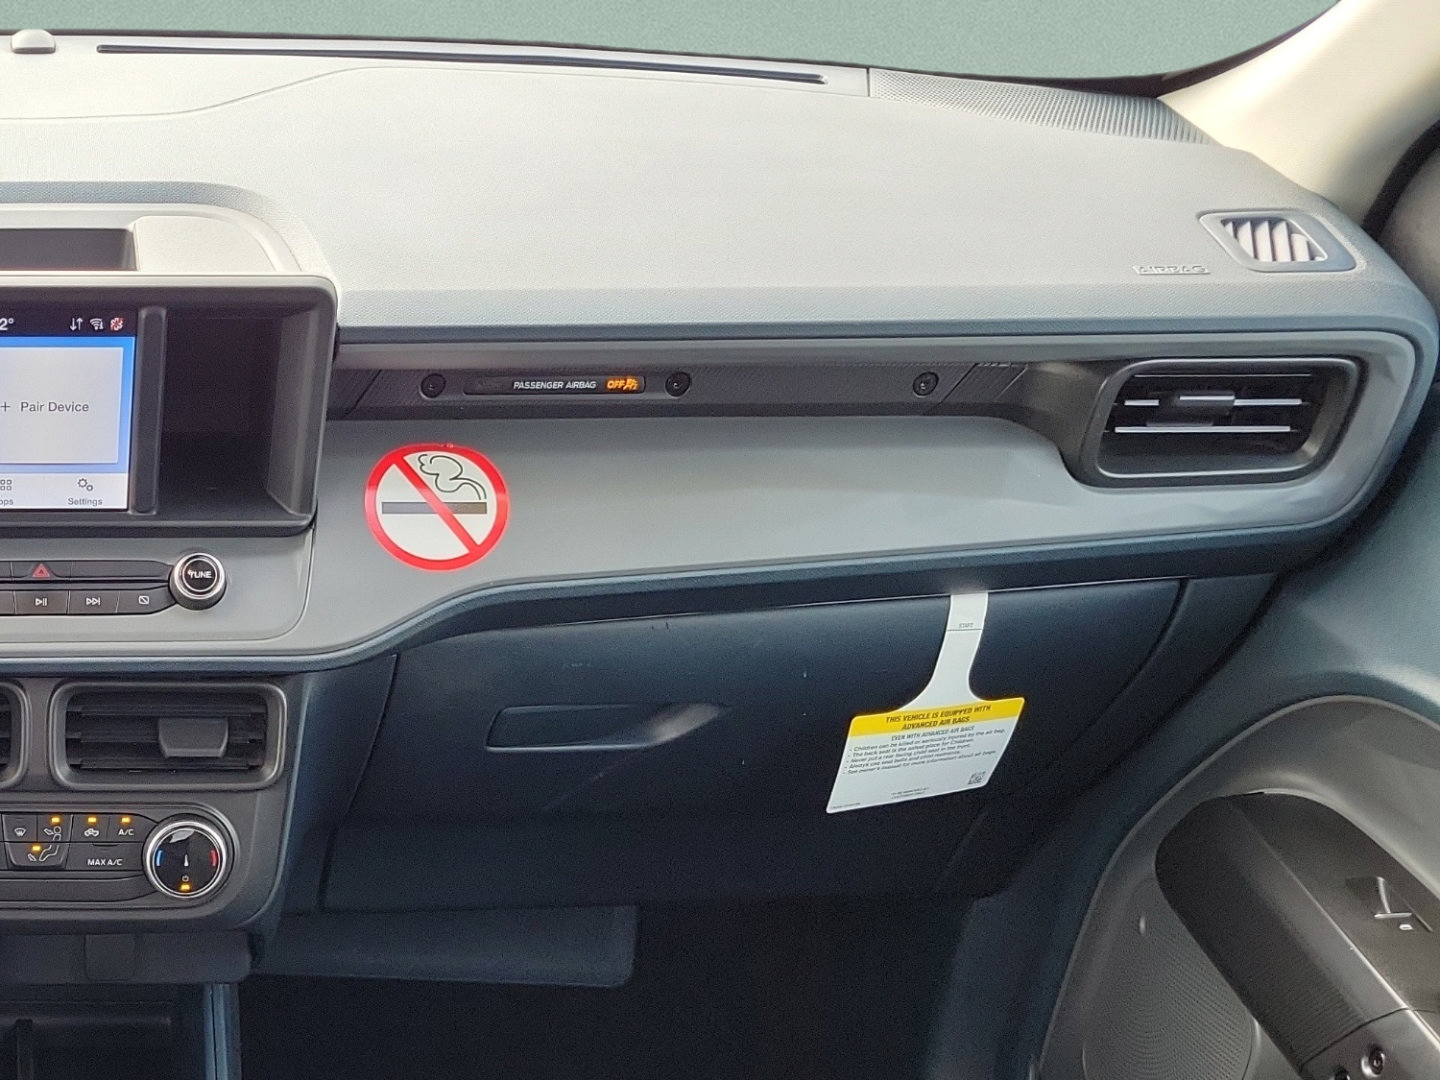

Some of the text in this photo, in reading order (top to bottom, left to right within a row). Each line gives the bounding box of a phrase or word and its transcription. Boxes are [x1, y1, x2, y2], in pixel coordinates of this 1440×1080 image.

[513, 379, 626, 390] PASSENGER AIRBAG OFF
[20, 401, 90, 413] Pair Device
[67, 496, 103, 508] Settings
[188, 569, 212, 579] TUNE
[886, 705, 991, 723] THIS VEHICLE IS EQUIPPED WITH
[901, 720, 938, 730] ADVANCED
[939, 718, 951, 726] AIR
[118, 827, 135, 837] A/C
[87, 857, 123, 867] MAX A/C
